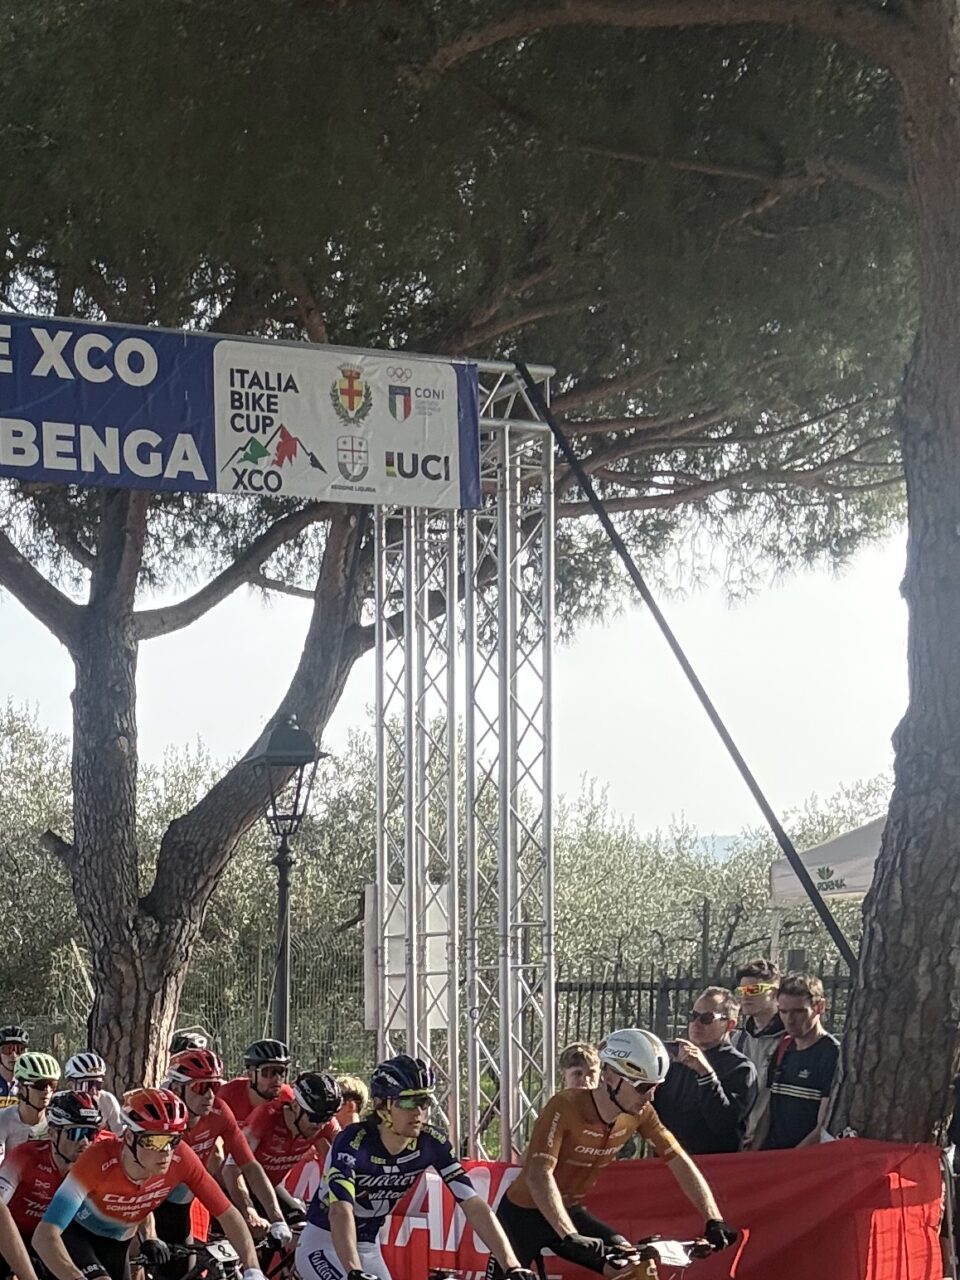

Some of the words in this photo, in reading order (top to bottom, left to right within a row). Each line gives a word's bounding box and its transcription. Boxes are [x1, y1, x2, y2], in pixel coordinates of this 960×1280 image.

[30, 328, 159, 387] XCO
[229, 368, 300, 394] ITALIA
[230, 390, 279, 414] BIKE
[414, 388, 445, 400] CONI
[230, 413, 275, 435] CUP
[397, 451, 451, 482] UCI
[230, 467, 283, 493] XCO
[356, 1169, 416, 1187] Wilier
[102, 1187, 171, 1204] CUBE
[218, 1244, 232, 1258] 8
